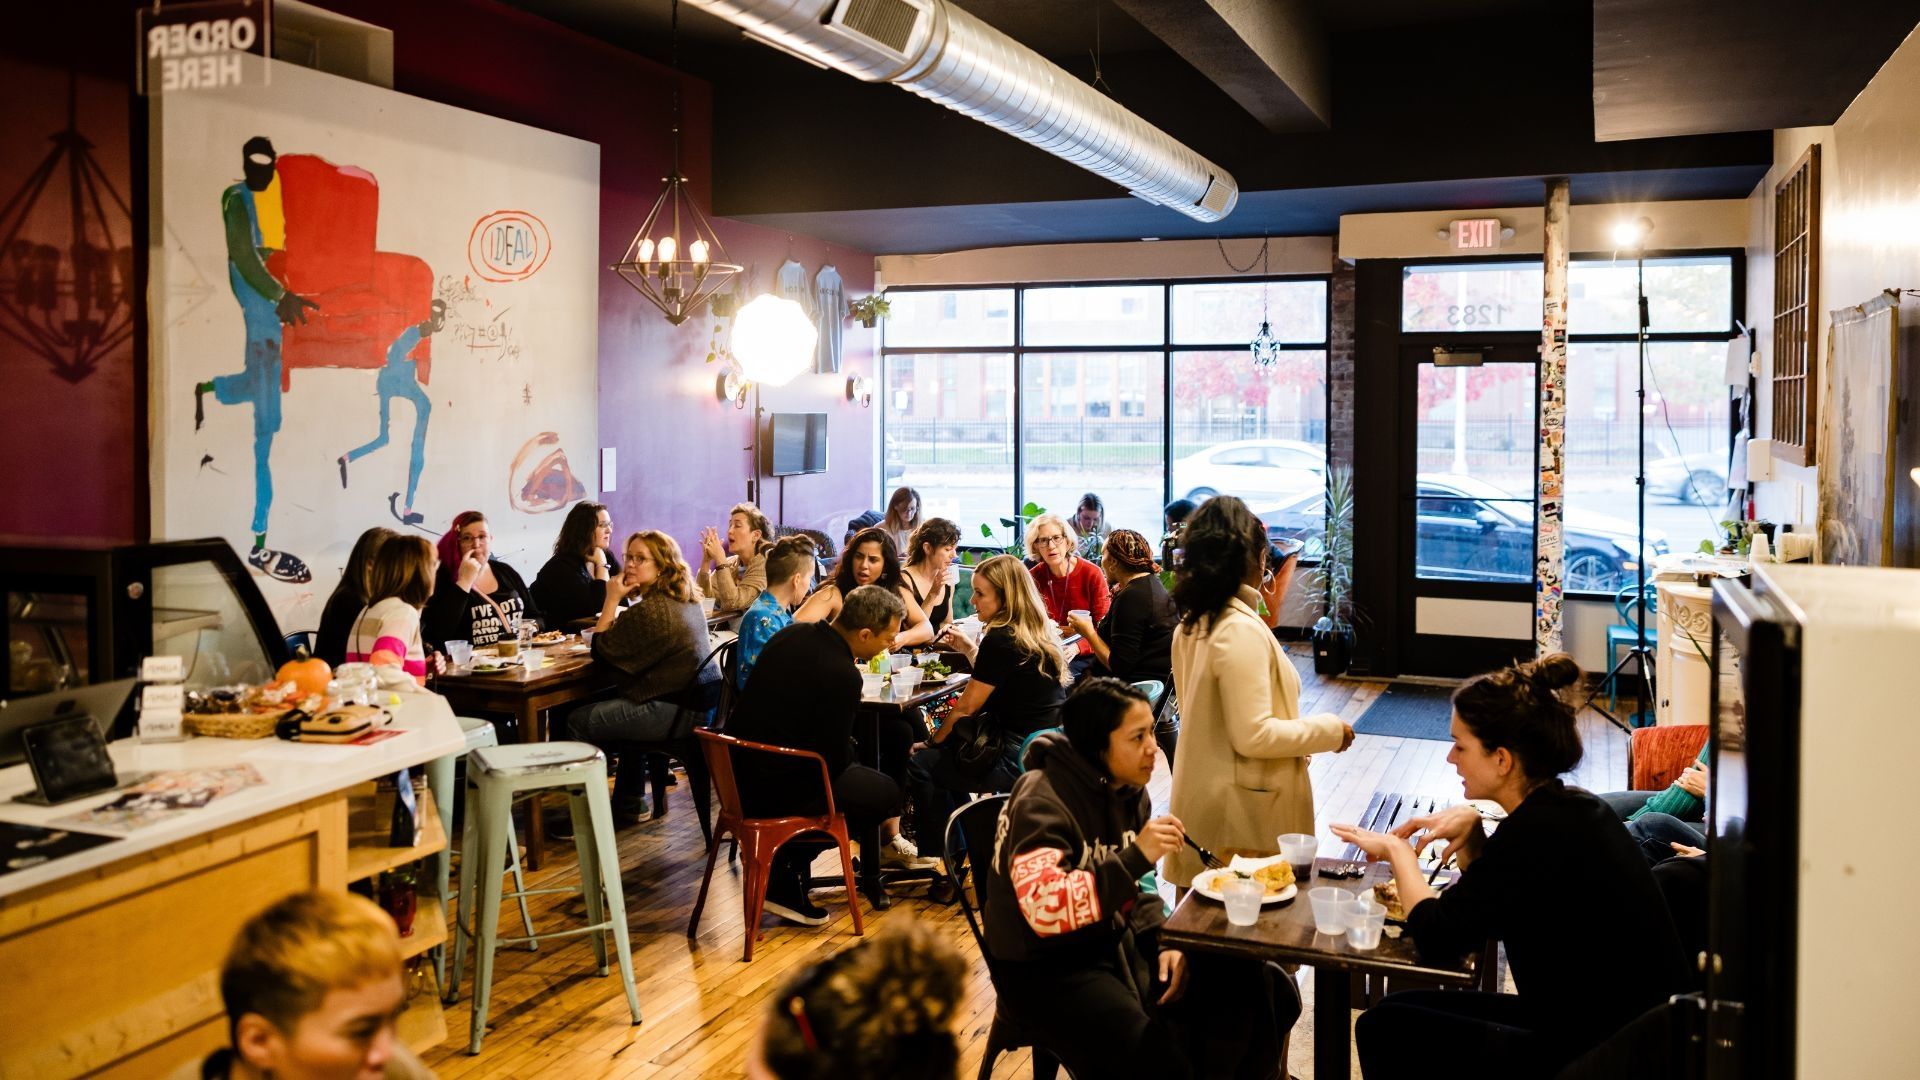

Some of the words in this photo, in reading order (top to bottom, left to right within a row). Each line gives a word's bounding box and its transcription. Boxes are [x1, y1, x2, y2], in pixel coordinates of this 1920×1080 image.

[489, 225, 533, 266] IDEAL
[1458, 220, 1495, 249] EXIT
[471, 604, 493, 620] I'VE
